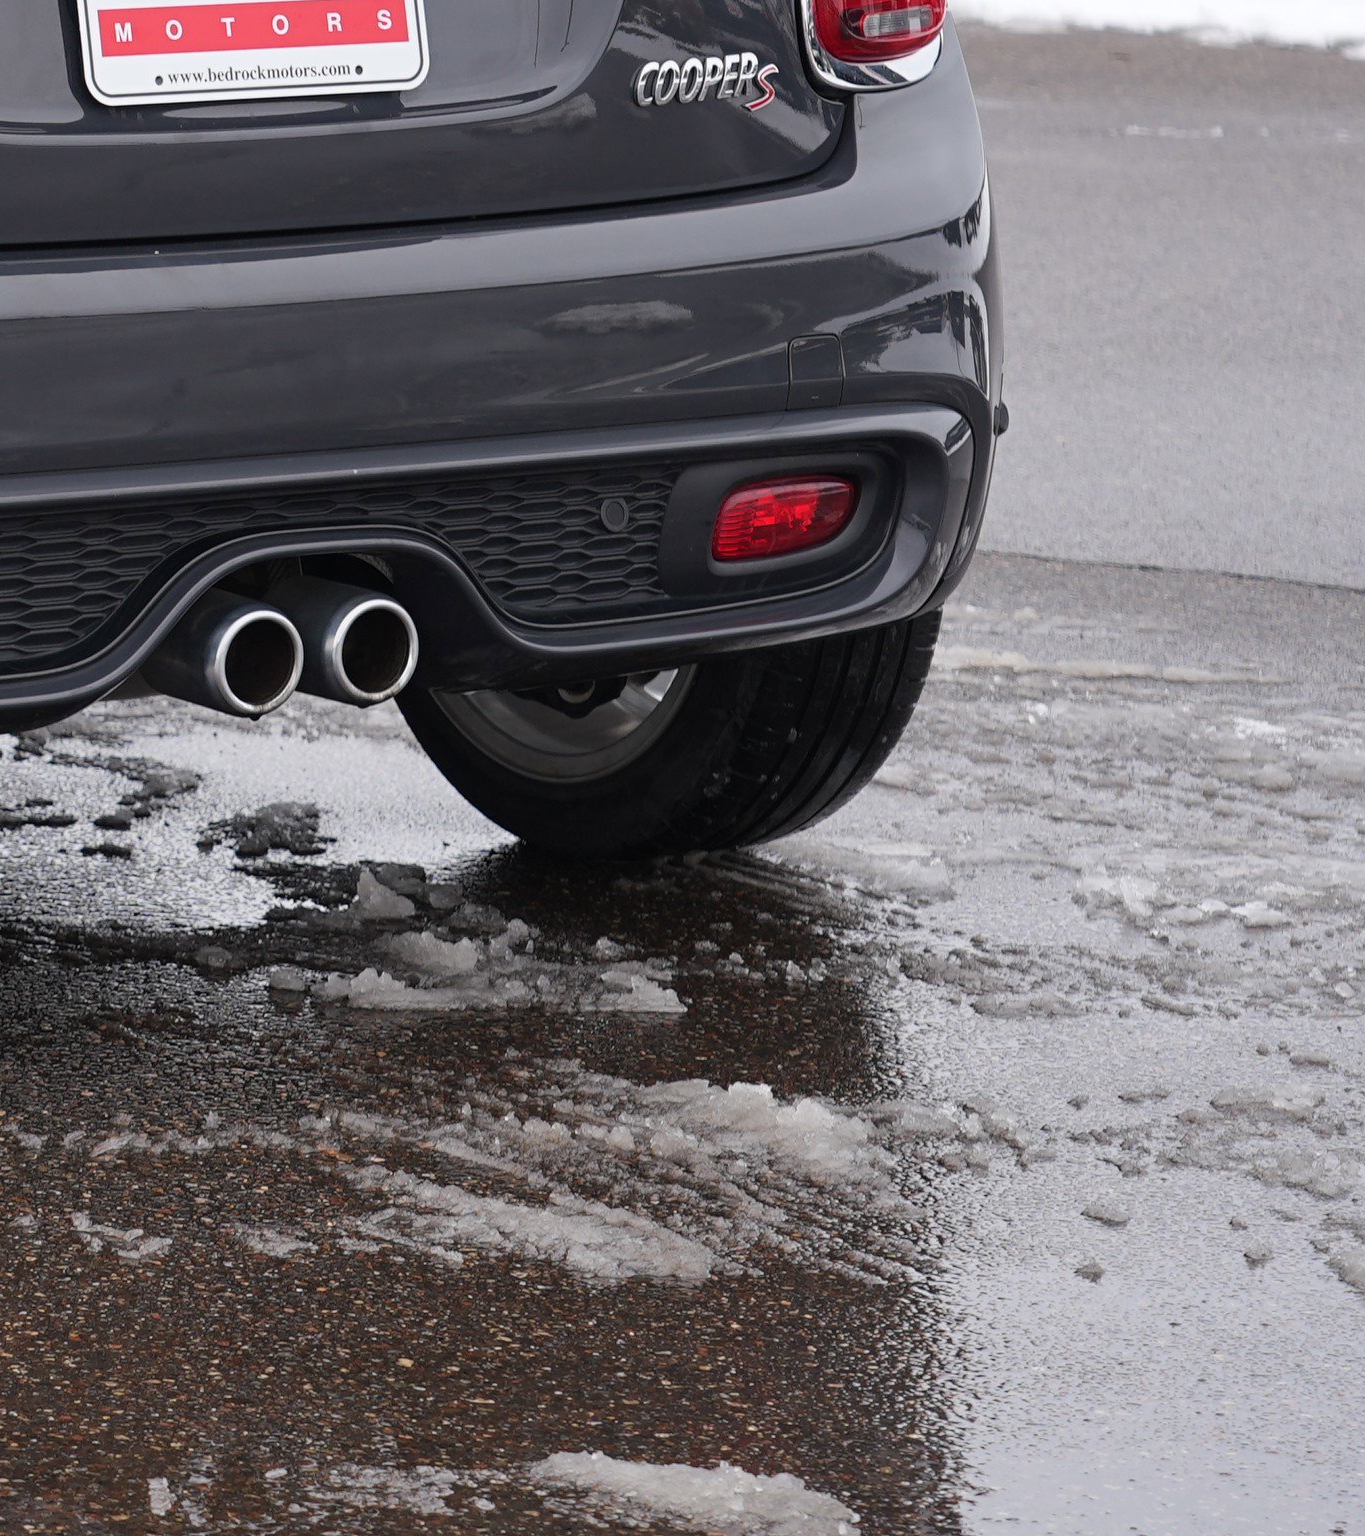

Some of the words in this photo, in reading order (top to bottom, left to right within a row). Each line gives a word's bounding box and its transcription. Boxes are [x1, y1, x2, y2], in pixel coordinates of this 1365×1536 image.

[114, 9, 392, 43] MOTORS
[168, 64, 351, 85] www.bedrockmotors.com
[636, 52, 758, 107] COOPER
